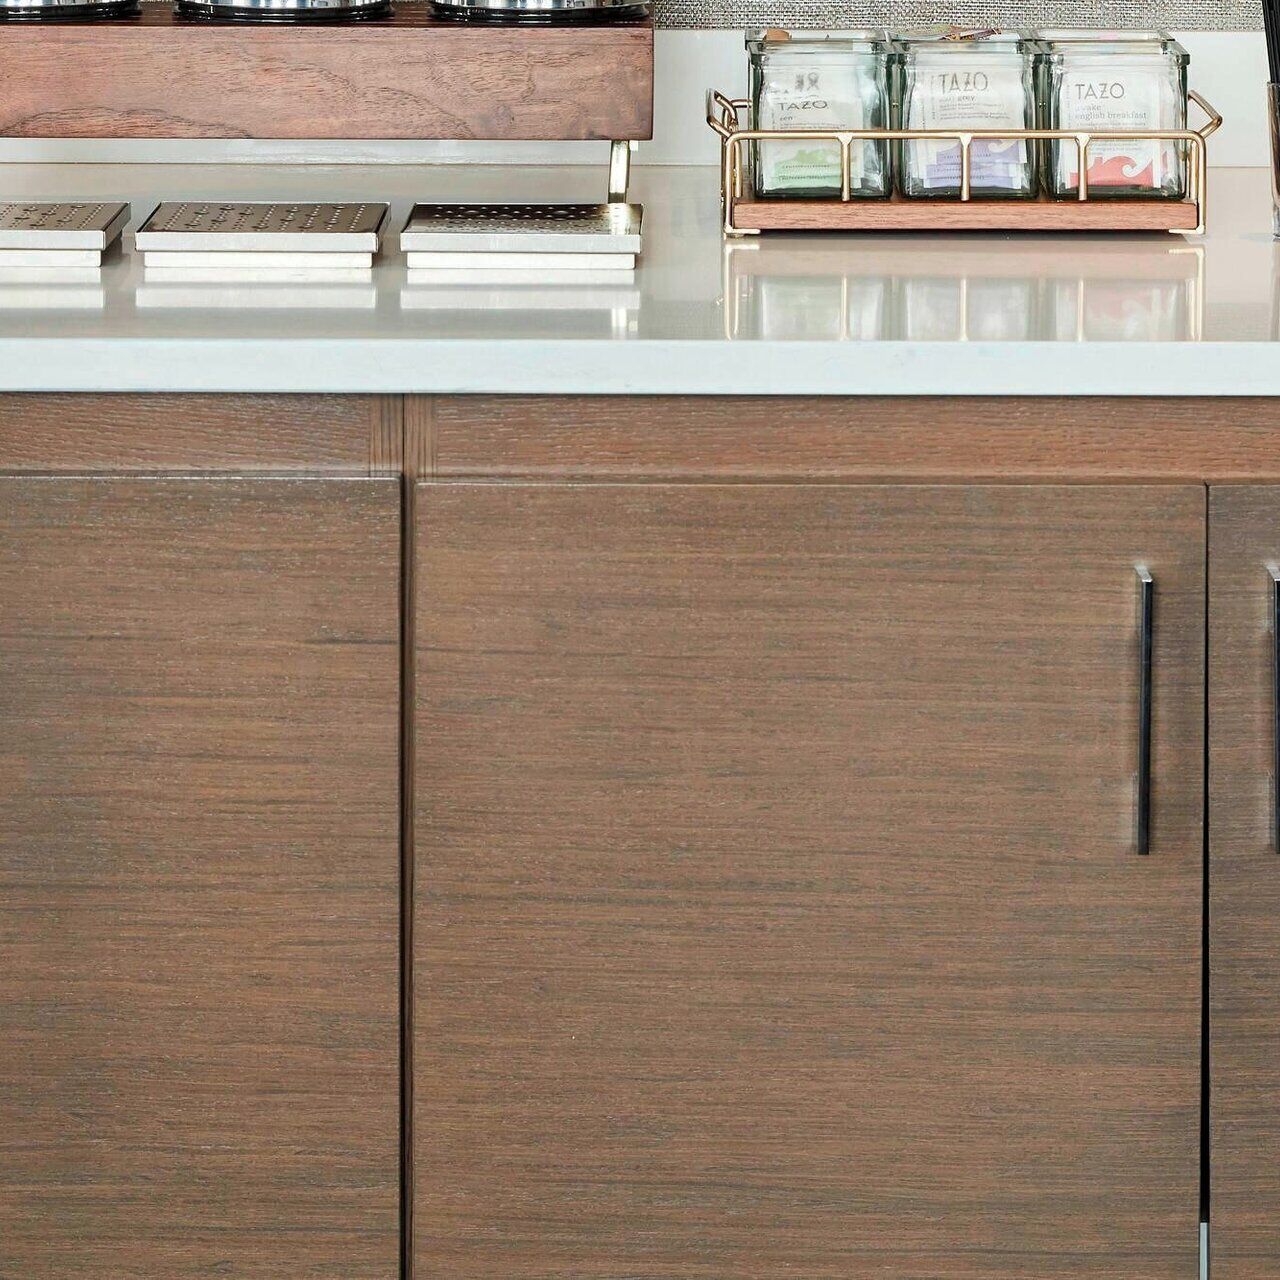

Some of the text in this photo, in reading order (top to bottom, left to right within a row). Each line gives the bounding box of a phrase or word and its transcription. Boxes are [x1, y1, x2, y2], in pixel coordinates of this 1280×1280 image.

[938, 71, 989, 94] TAZO
[1075, 82, 1125, 100] TAZO
[778, 100, 829, 111] TAZO
[1075, 111, 1147, 122] english breakfast
